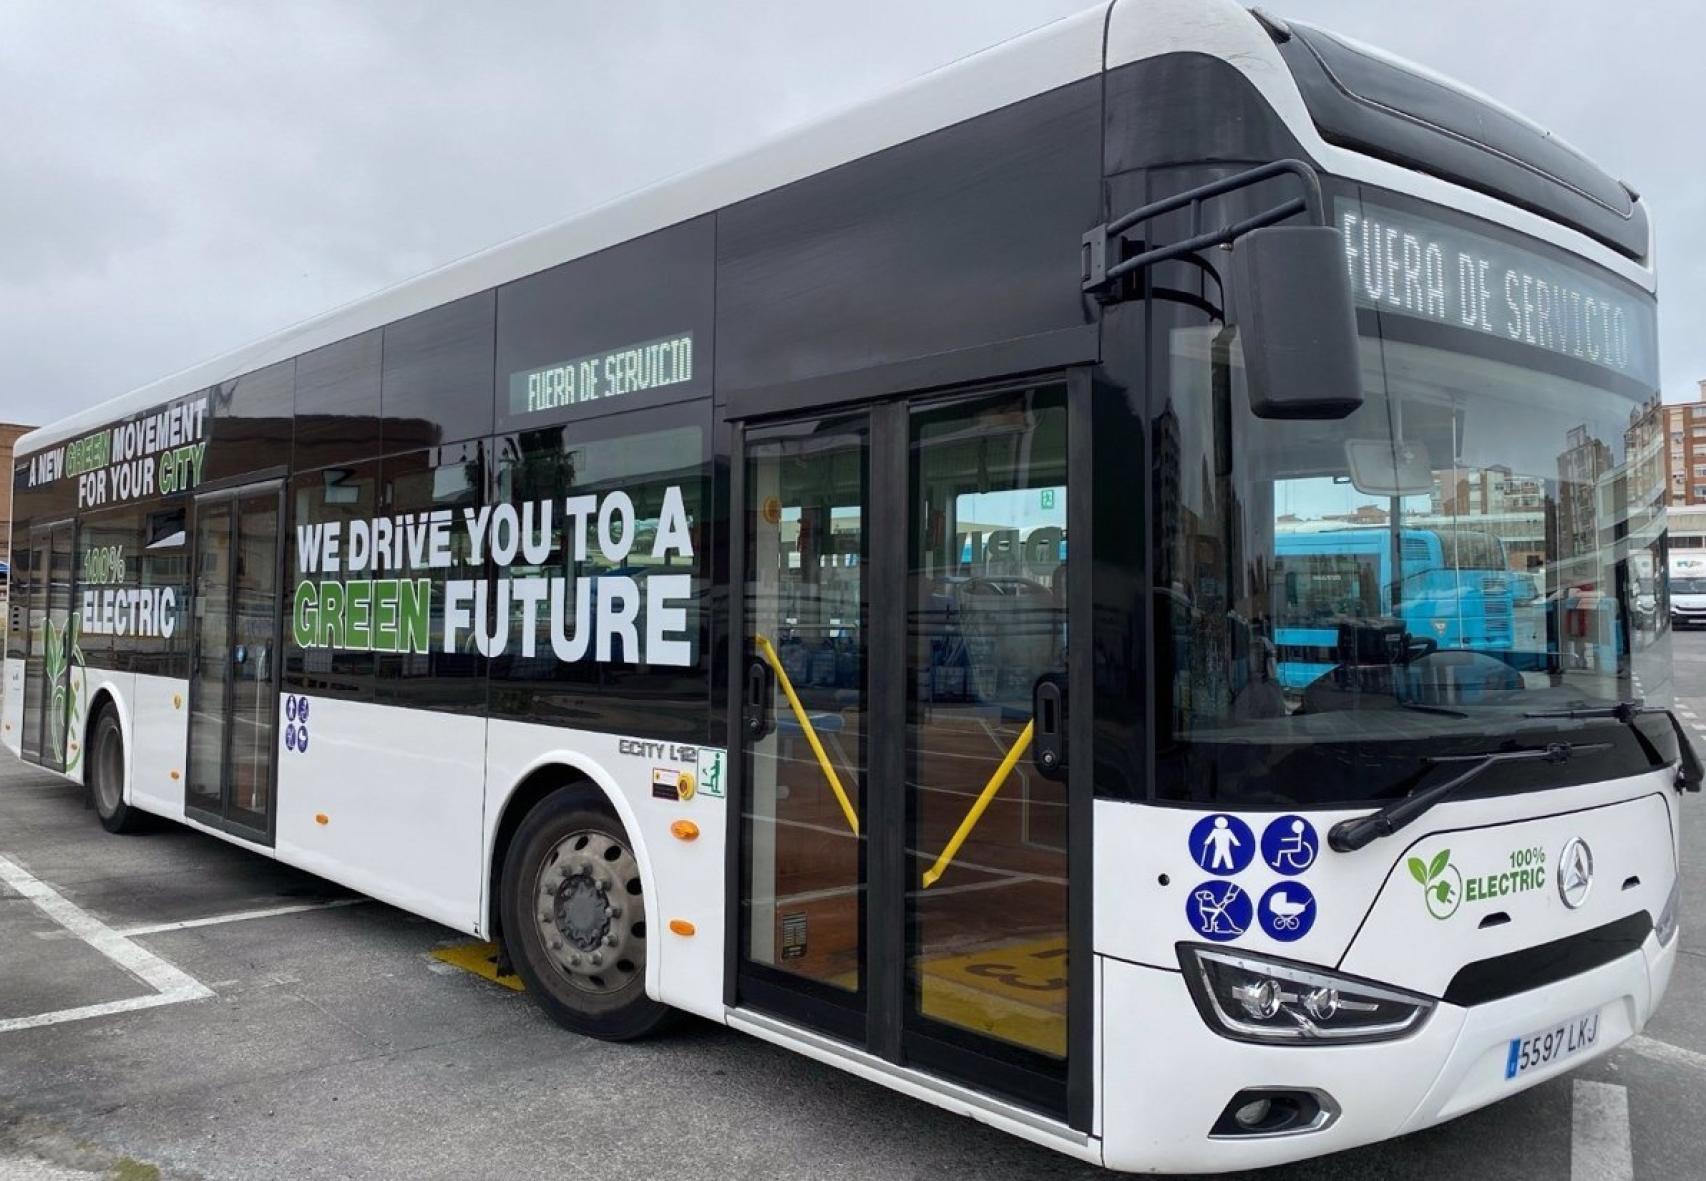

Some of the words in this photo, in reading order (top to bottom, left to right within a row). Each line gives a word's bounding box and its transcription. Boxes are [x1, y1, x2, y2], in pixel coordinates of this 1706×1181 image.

[1344, 213, 1444, 318] FUERA
[1459, 252, 1493, 332] DE
[1504, 269, 1628, 370] SERVICIO
[528, 364, 575, 412] FUERA
[580, 358, 599, 400] DE
[604, 337, 692, 398] SERVICIO
[28, 457, 36, 487] A
[38, 447, 65, 484] NEW
[66, 429, 110, 478] GREEN
[112, 398, 207, 463] MOVEMENT
[78, 467, 106, 508] FOR
[110, 458, 154, 500] YOUR
[158, 442, 206, 495] CITY
[297, 521, 341, 574] WE
[348, 510, 453, 571] DRIVE
[464, 499, 553, 566] YOU
[566, 490, 635, 562] TO
[652, 486, 694, 559] A
[84, 544, 126, 584] 100%
[82, 586, 176, 639] ELECTRIC
[293, 577, 431, 654] GREEN
[444, 574, 691, 667] FUTURE
[619, 739, 664, 759] ECITY
[1466, 866, 1545, 902] ELECTRIC
[1510, 847, 1545, 868] 100%
[1520, 1027, 1564, 1070] 5597
[1568, 1014, 1598, 1053] LKJ
